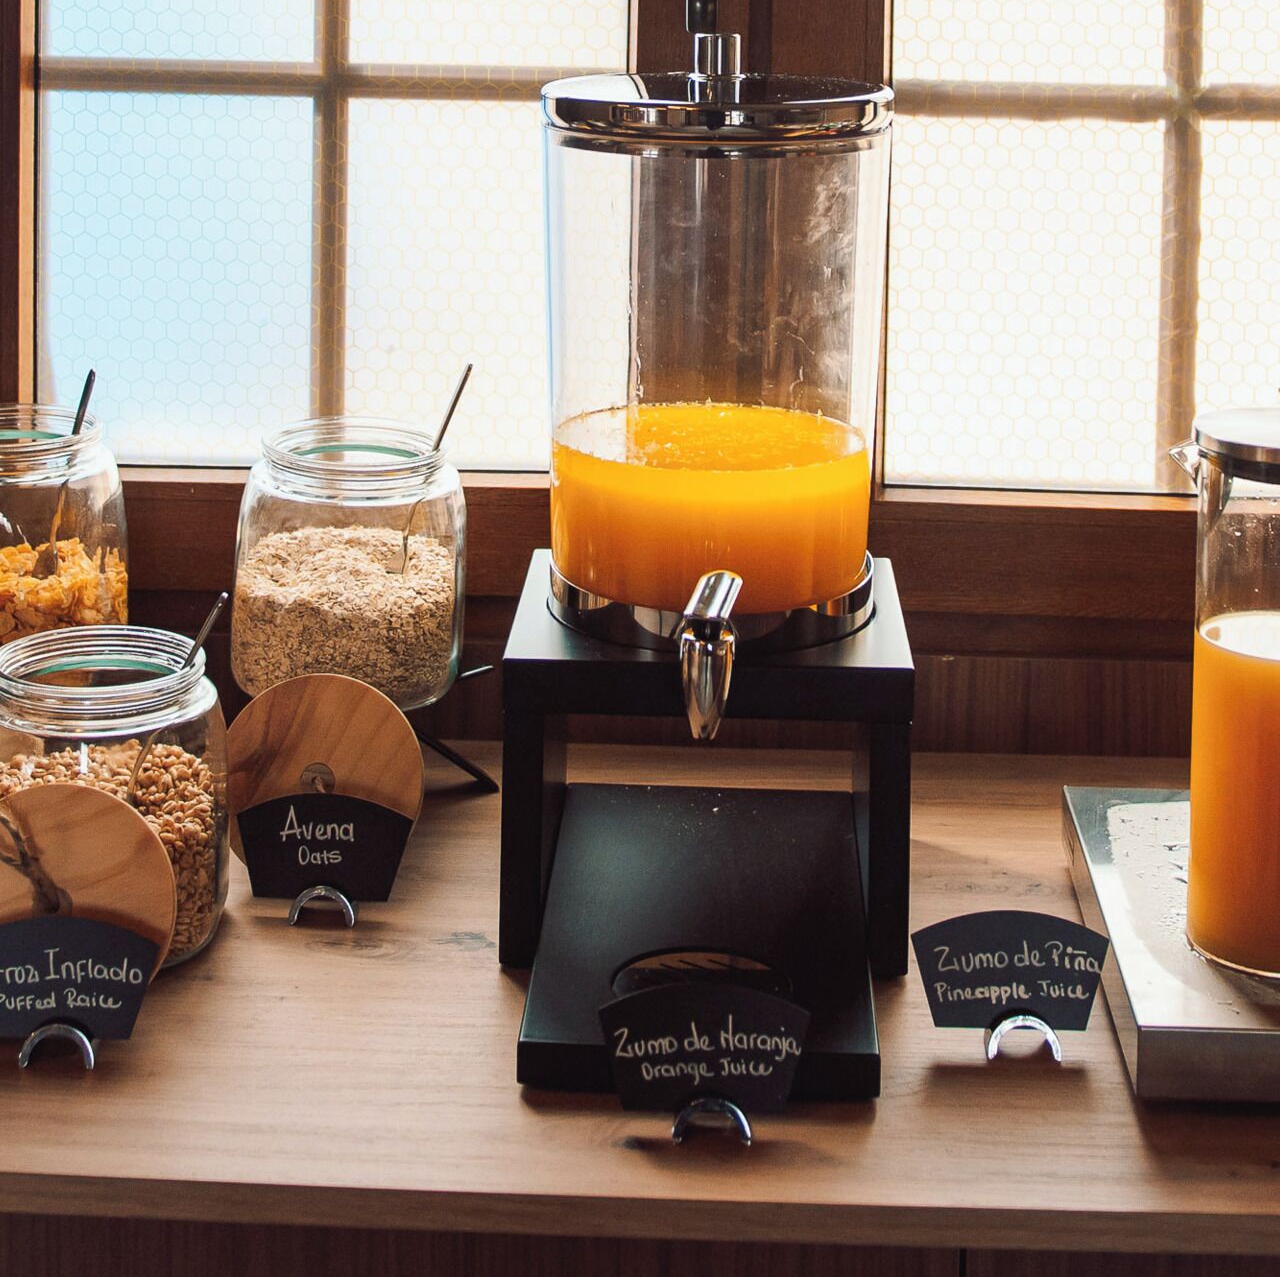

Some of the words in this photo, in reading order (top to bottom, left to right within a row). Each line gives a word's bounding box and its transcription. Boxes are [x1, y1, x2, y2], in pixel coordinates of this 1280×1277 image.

[280, 804, 355, 842] Avena
[298, 845, 342, 865] Oats
[44, 948, 143, 985] Inflado
[933, 945, 1009, 973] Zumo
[1013, 940, 1046, 967] de
[1044, 941, 1101, 974] Piña
[934, 981, 1032, 1006] Pineapple
[1037, 980, 1090, 999] Juice
[614, 1027, 678, 1058] Zumo
[683, 1021, 715, 1052] de
[720, 1013, 802, 1062] Naranja
[641, 1061, 715, 1085] Orange
[719, 1058, 773, 1076] Juice
